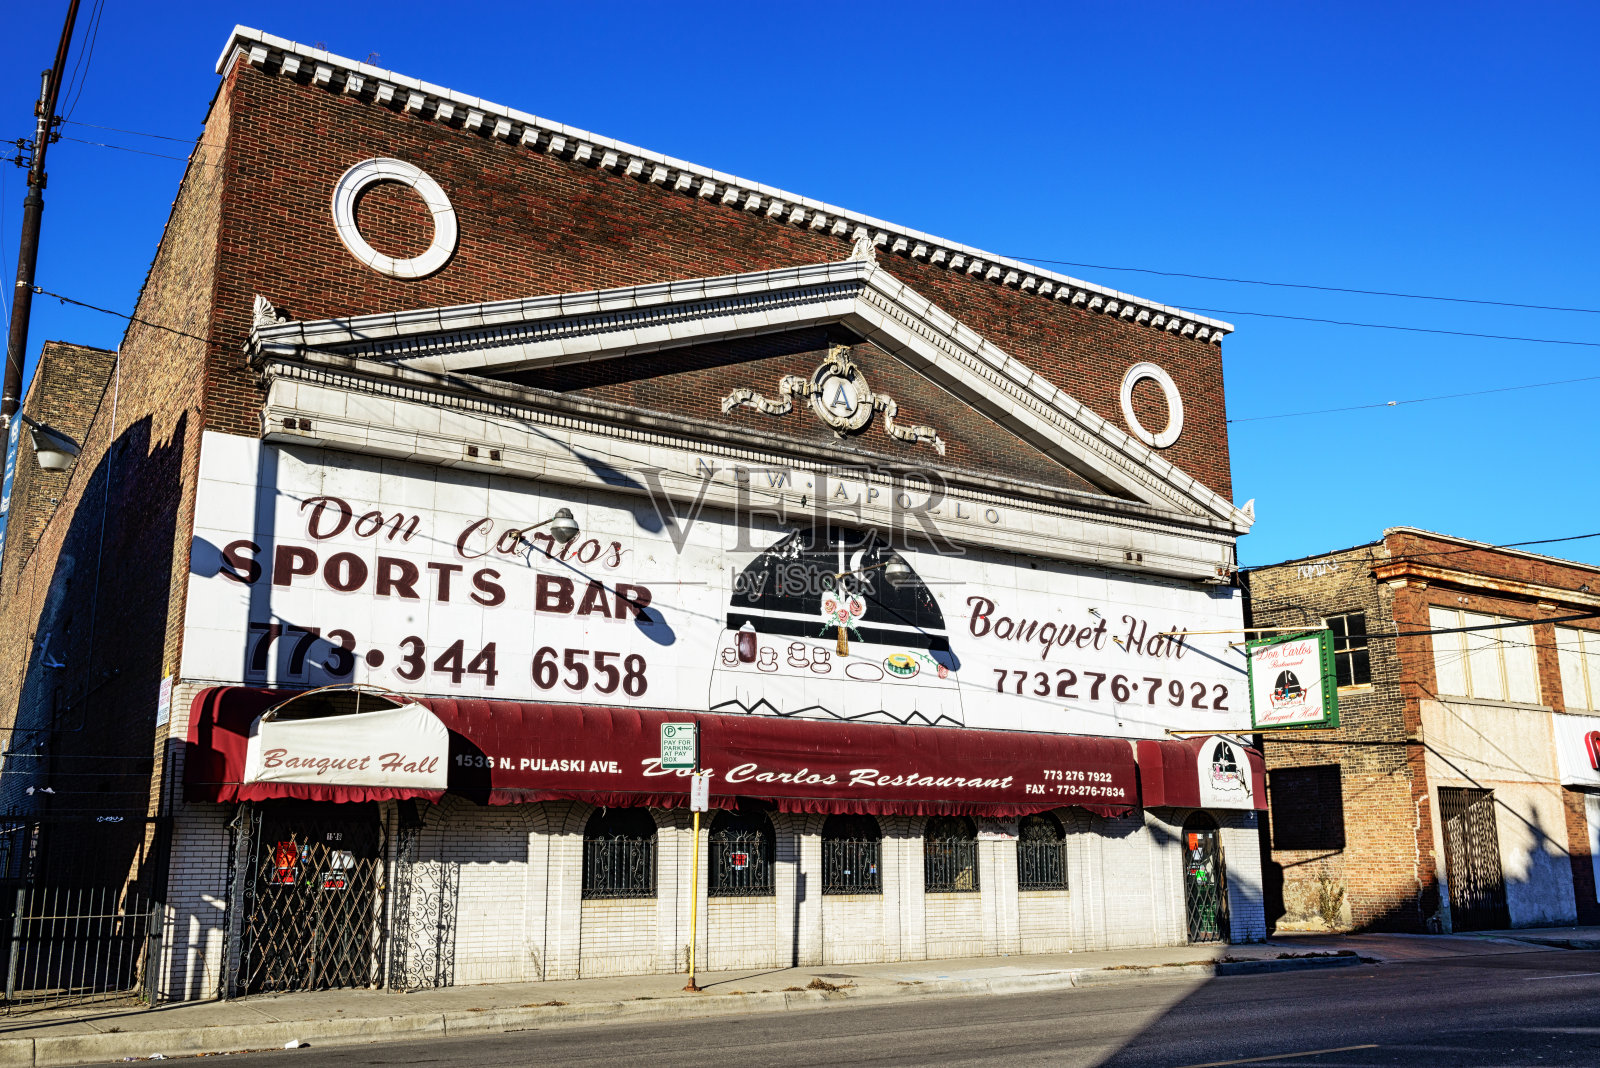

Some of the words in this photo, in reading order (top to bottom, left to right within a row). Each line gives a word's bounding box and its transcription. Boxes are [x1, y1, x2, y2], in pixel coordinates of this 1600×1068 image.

[830, 383, 853, 412] A
[833, 482, 1001, 525] APOLLO
[301, 495, 422, 542] Don
[219, 539, 506, 608] SPORTS
[536, 573, 654, 623] BAR
[966, 596, 1108, 661] Banquet
[1121, 614, 1190, 660] Hall
[1256, 646, 1279, 662] Don
[1282, 642, 1312, 658] Carlos
[532, 646, 648, 697] 6558
[1259, 710, 1295, 725] Banquet
[1298, 705, 1321, 719] Hall
[263, 748, 371, 776] Banquet
[377, 751, 440, 774] Hall
[455, 753, 495, 768] 1536
[499, 757, 516, 770] N.
[520, 757, 585, 773] PULASKI
[588, 758, 623, 774] AVE.
[724, 762, 838, 786] Carlos
[848, 767, 1013, 790] Restaurant
[1043, 769, 1063, 781] 773
[1065, 770, 1085, 782] 276
[1087, 771, 1112, 783] 7922
[1025, 784, 1046, 795] FAX
